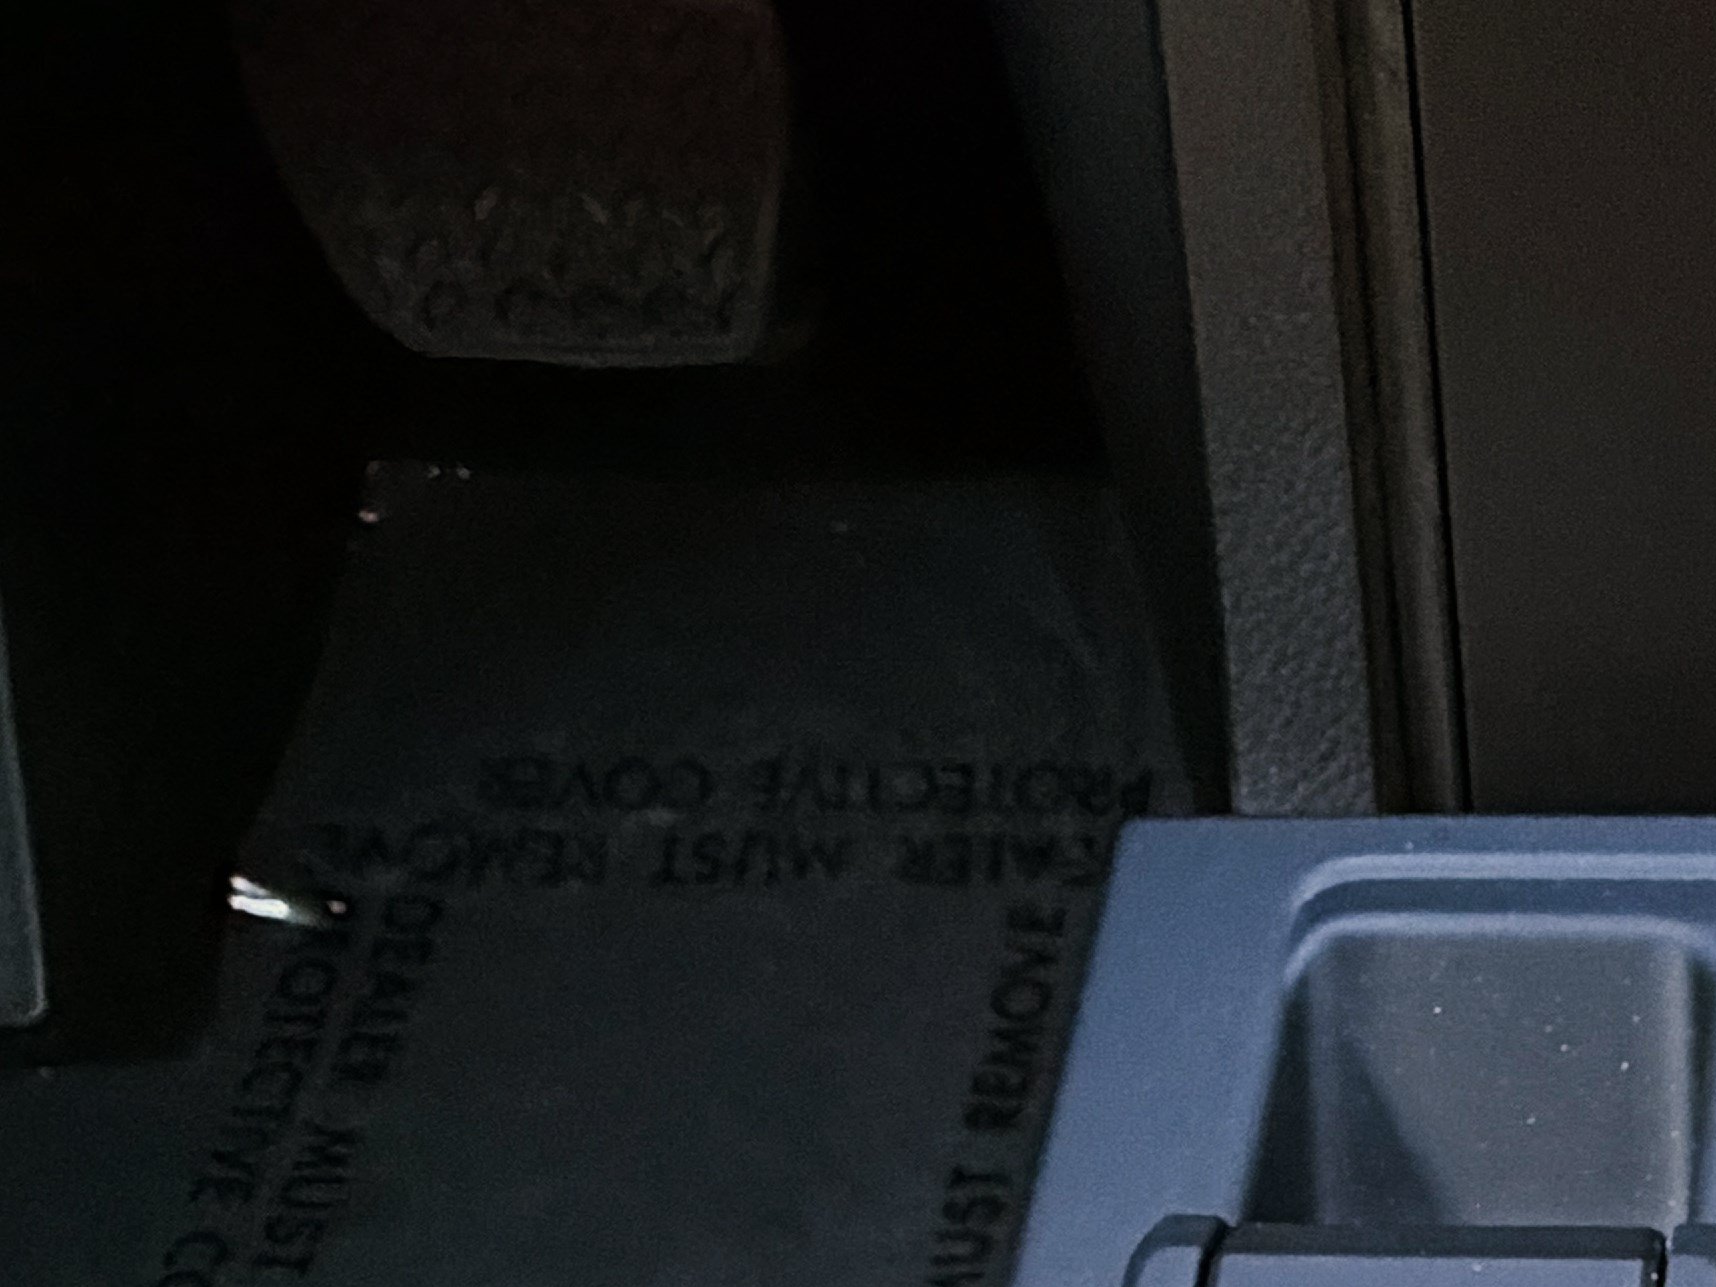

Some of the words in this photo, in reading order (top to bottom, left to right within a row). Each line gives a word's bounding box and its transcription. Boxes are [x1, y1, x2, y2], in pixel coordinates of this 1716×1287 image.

[477, 755, 712, 809] COVER
[650, 830, 854, 887] MUST
[894, 830, 1107, 887] EALER
[331, 893, 444, 1088] DEALER
[961, 905, 1067, 1134] REMOVE
[252, 1118, 364, 1278] MUST
